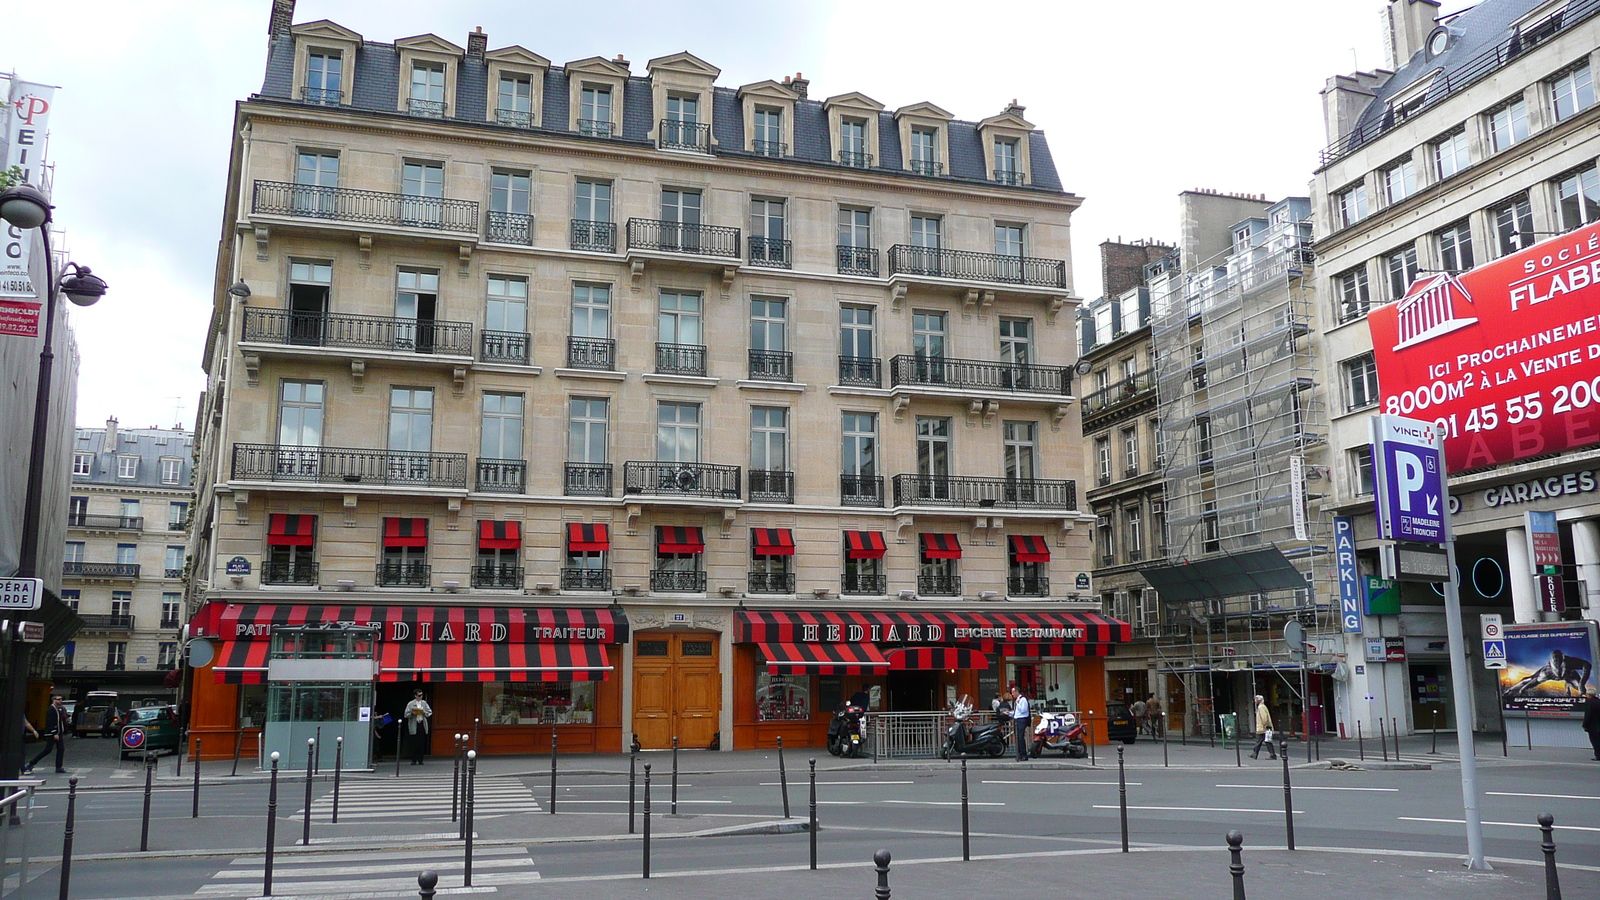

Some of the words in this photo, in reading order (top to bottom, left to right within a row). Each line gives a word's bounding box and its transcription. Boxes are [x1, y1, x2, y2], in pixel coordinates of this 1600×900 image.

[1428, 362, 1450, 380] ICI
[1457, 314, 1600, 371] PROCHAINEME
[1495, 368, 1518, 387] LA
[1520, 348, 1582, 378] VENTE
[1464, 403, 1498, 433] 45
[1506, 391, 1543, 424] 55
[1393, 426, 1422, 438] VINCI
[1395, 450, 1424, 512] P
[1484, 471, 1595, 507] GARAGES
[1412, 517, 1440, 528] MADELEINE
[1413, 527, 1438, 538] TRONCHET
[1337, 521, 1358, 628] PARKING
[1370, 578, 1393, 589] ELAN
[1547, 576, 1557, 612] ROVER
[236, 624, 281, 635] PATI
[533, 627, 606, 639] TRAITEUR
[802, 624, 942, 642] HEDIARD
[954, 628, 1006, 638] EPICERIE
[1011, 628, 1083, 638] RESTAURANT
